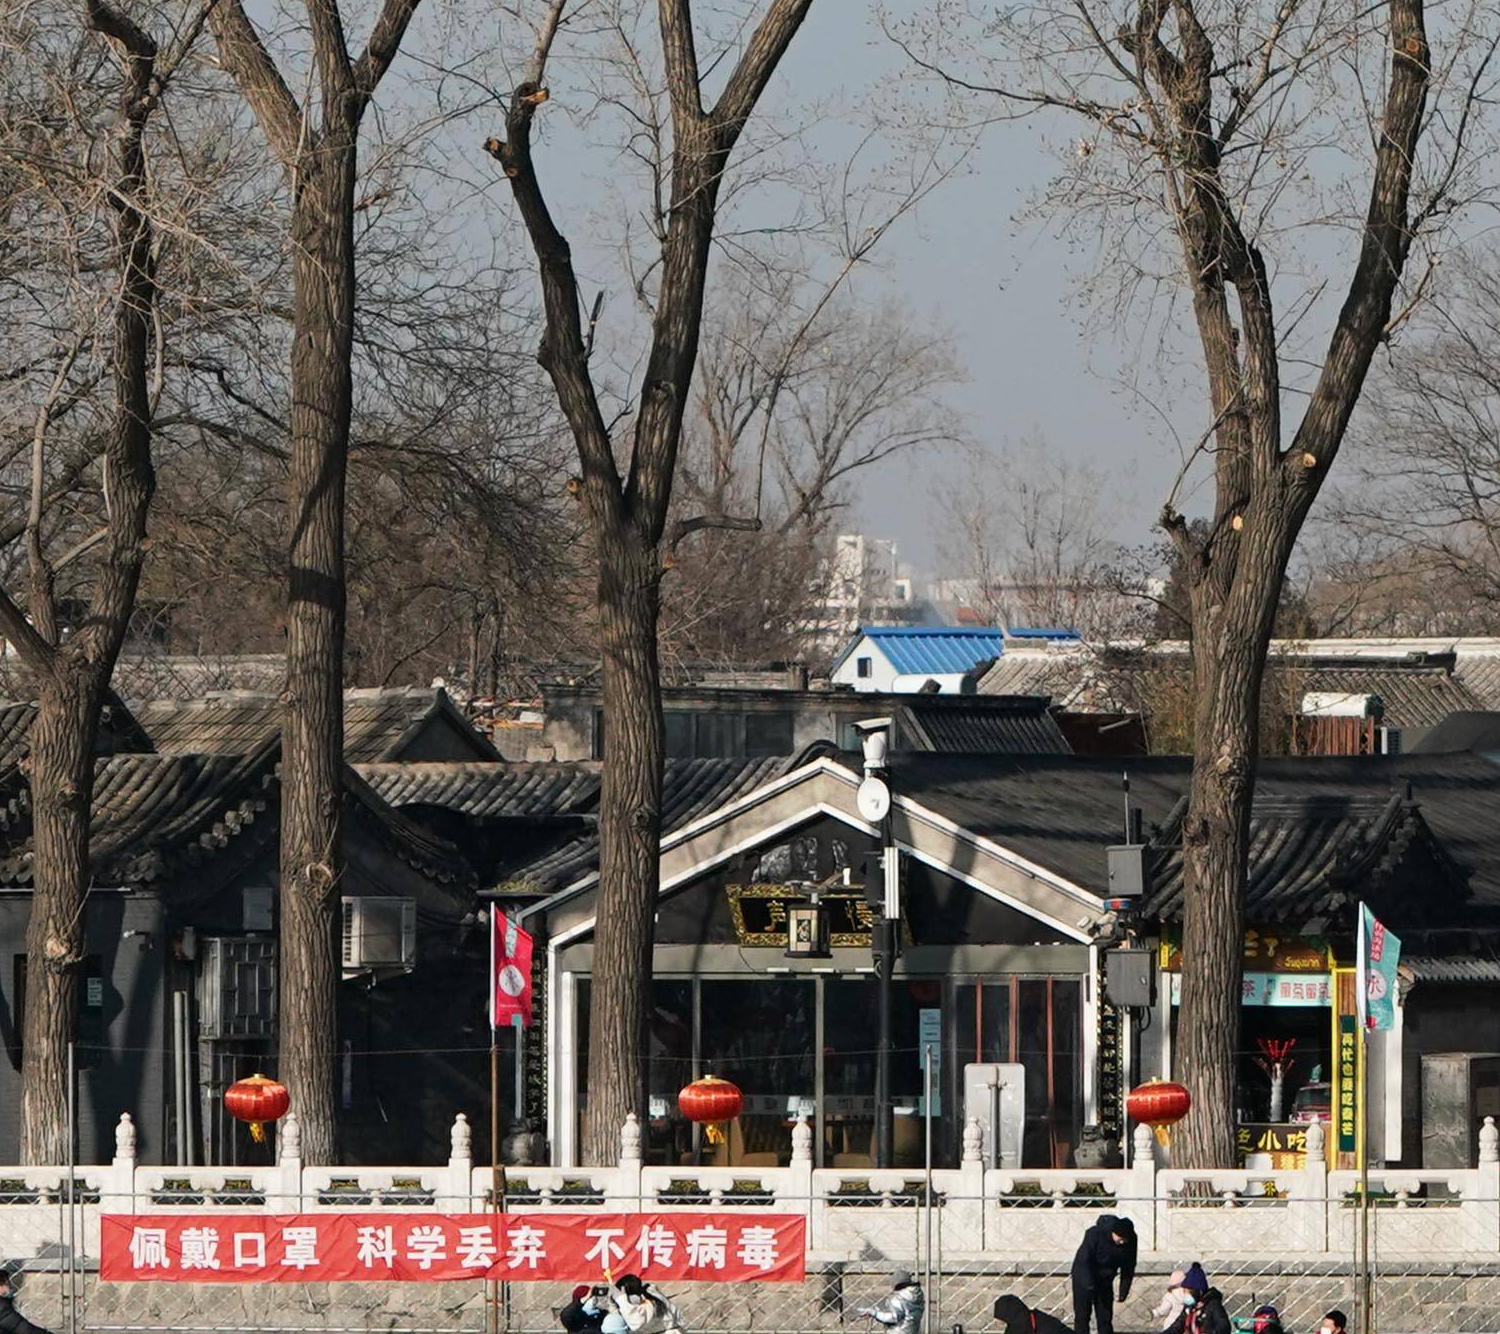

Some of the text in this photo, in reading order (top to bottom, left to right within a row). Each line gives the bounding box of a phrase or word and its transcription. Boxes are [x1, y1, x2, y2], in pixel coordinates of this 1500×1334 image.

[129, 1224, 779, 1272] 佩戴口罩 科学丢弃 不传病毒
